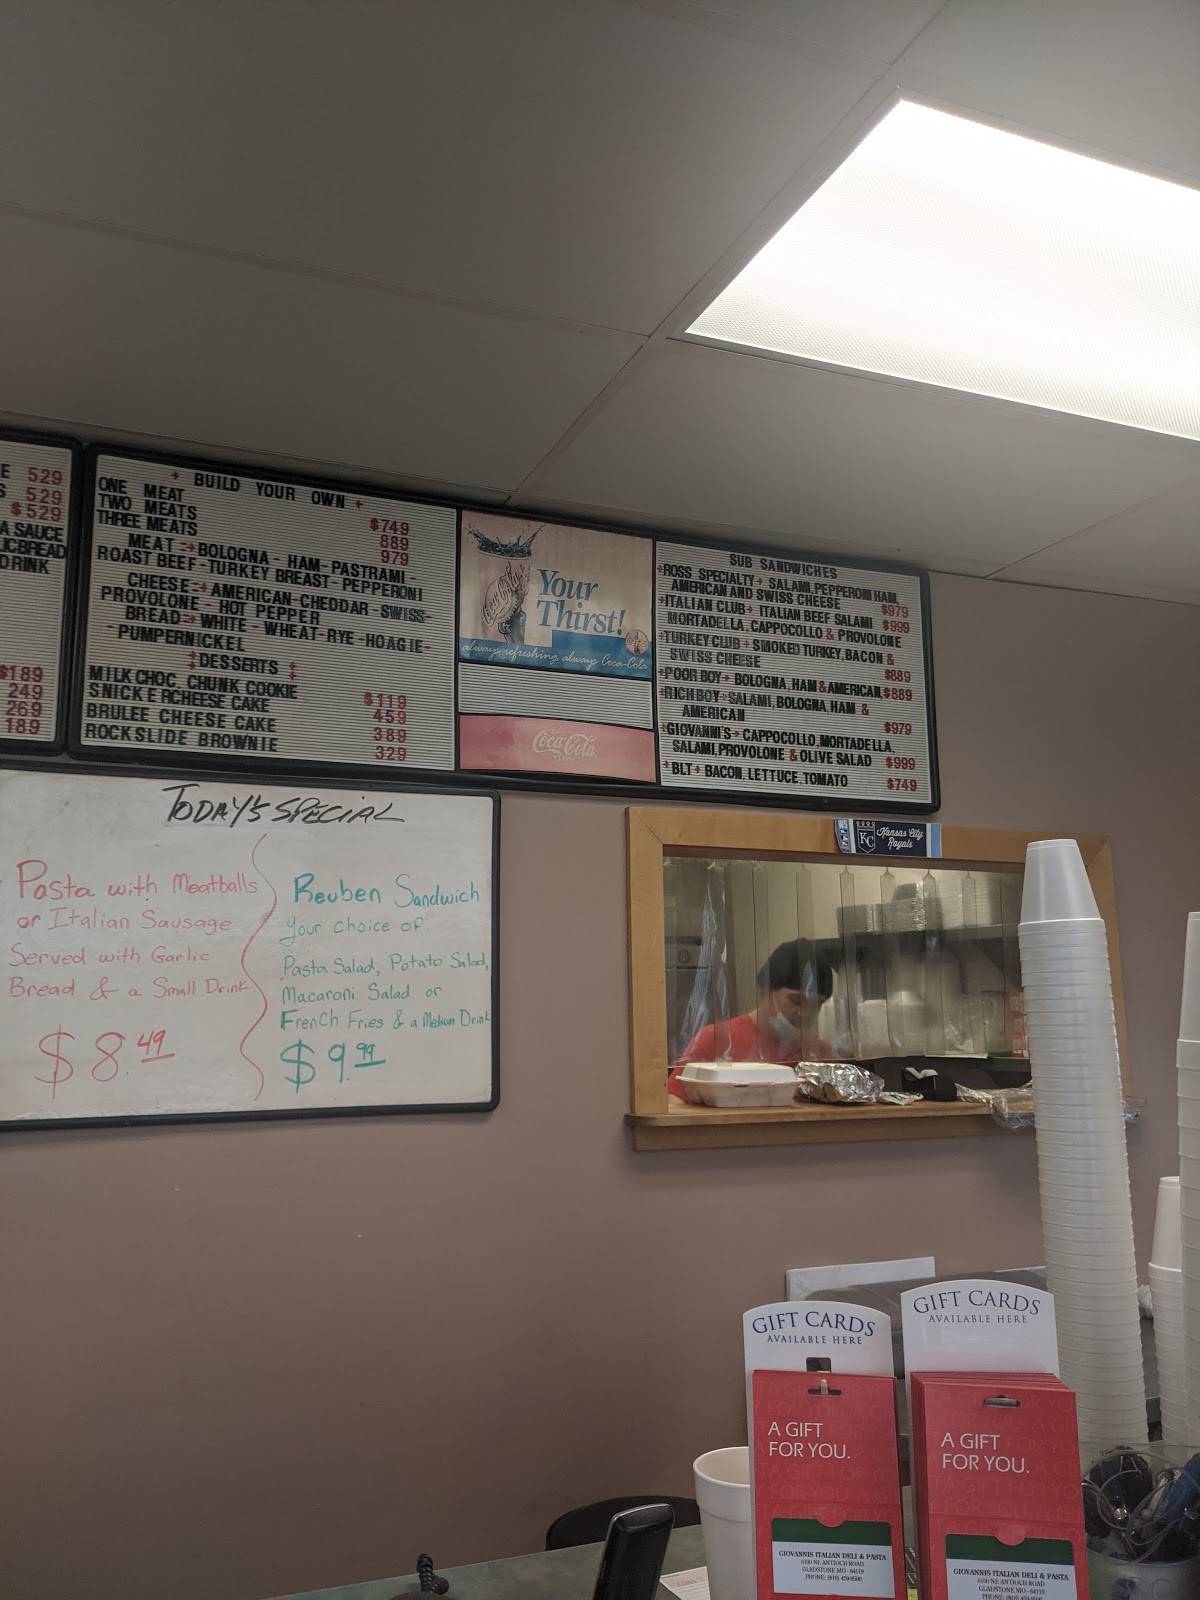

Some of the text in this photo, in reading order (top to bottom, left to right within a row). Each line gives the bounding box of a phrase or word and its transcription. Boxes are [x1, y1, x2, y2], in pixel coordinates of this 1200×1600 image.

[28, 467, 62, 485] 529
[26, 487, 62, 505] 529
[99, 477, 184, 502] ONE MEAT
[194, 473, 345, 508] BUILD YOUR OWN
[11, 501, 62, 522] $529
[99, 494, 197, 520] TWO MEATS
[15, 522, 63, 542] SAUCE
[96, 510, 197, 536] THREE MEATS
[370, 518, 409, 536] $749
[128, 533, 175, 552] MEAT
[380, 535, 409, 551] 889
[97, 545, 152, 566] ROAST
[207, 559, 270, 580] TURKEY
[381, 550, 409, 566] 979
[730, 554, 837, 579] SUB SANDWICHES
[128, 572, 190, 593] CHEESE
[537, 568, 598, 600] Your
[664, 564, 754, 586] ROSS SPECIALTY
[672, 579, 909, 618] AMERICAN AND SWISS CHEESE $979
[126, 606, 181, 625] BREAD
[219, 600, 247, 616] HOT
[256, 604, 320, 625] PEPPER
[537, 600, 626, 635] Thirst!
[665, 594, 910, 633] ITALIAN CLUB ITALIAN BEEF SALAMI $999
[118, 625, 244, 651] PUMPERNICKEL
[751, 620, 901, 648] CAPPOCOLLO PROVOLONE
[462, 641, 500, 656] always
[664, 631, 709, 646] TURKEY
[752, 639, 800, 655] SMOKED
[845, 649, 883, 664] BACON
[200, 653, 278, 674] DESSERTS
[717, 651, 911, 683] CHEESE $889
[9, 683, 43, 700] 249
[187, 675, 297, 699] CHUNK COOKIE
[792, 678, 912, 701] HAM $889
[6, 700, 42, 717] 269
[232, 696, 269, 713] CAKE
[831, 700, 856, 715] HAM
[5, 718, 40, 735] 189
[87, 703, 276, 732] BRULEE CHEESE CAKE
[374, 709, 406, 725] 459
[682, 705, 912, 735] AMERICAN $979
[198, 733, 278, 751] BROWNIE
[374, 727, 406, 743] 389
[375, 746, 406, 761] 329
[719, 743, 916, 770] PROVOLONE OLIVE SALAD $999
[672, 762, 917, 791] BLT TOMATO $749
[271, 795, 404, 823] SPECIAL
[876, 827, 907, 839] Kansas
[887, 837, 913, 850] Royals
[16, 859, 257, 899] Pasta with Meatballs
[293, 872, 479, 908] Reuben Sandwich
[17, 907, 232, 935] or Italian Sausage
[333, 918, 423, 934] choice of
[9, 943, 209, 967] Served with Garlic
[284, 952, 489, 977] Pasta Salad, Potato Salad,
[9, 976, 248, 1000] Bread & a Small Drink
[282, 983, 442, 1005] Macaroni Salad or
[280, 1008, 491, 1031] French Fries & Drink
[913, 1290, 1041, 1316] GIFT CARDS
[752, 1311, 875, 1337] GIFT CARDS
[928, 1315, 1027, 1324] AVAILABLE HERE
[767, 1334, 862, 1345] AVAILABLE HERE
[768, 1422, 824, 1438] A GIFT
[769, 1442, 851, 1460] FOR YOU.
[941, 1433, 1000, 1451] A GIFT
[942, 1454, 1030, 1474] FOR YOU.
[993, 1570, 1019, 1578] ITALIAN
